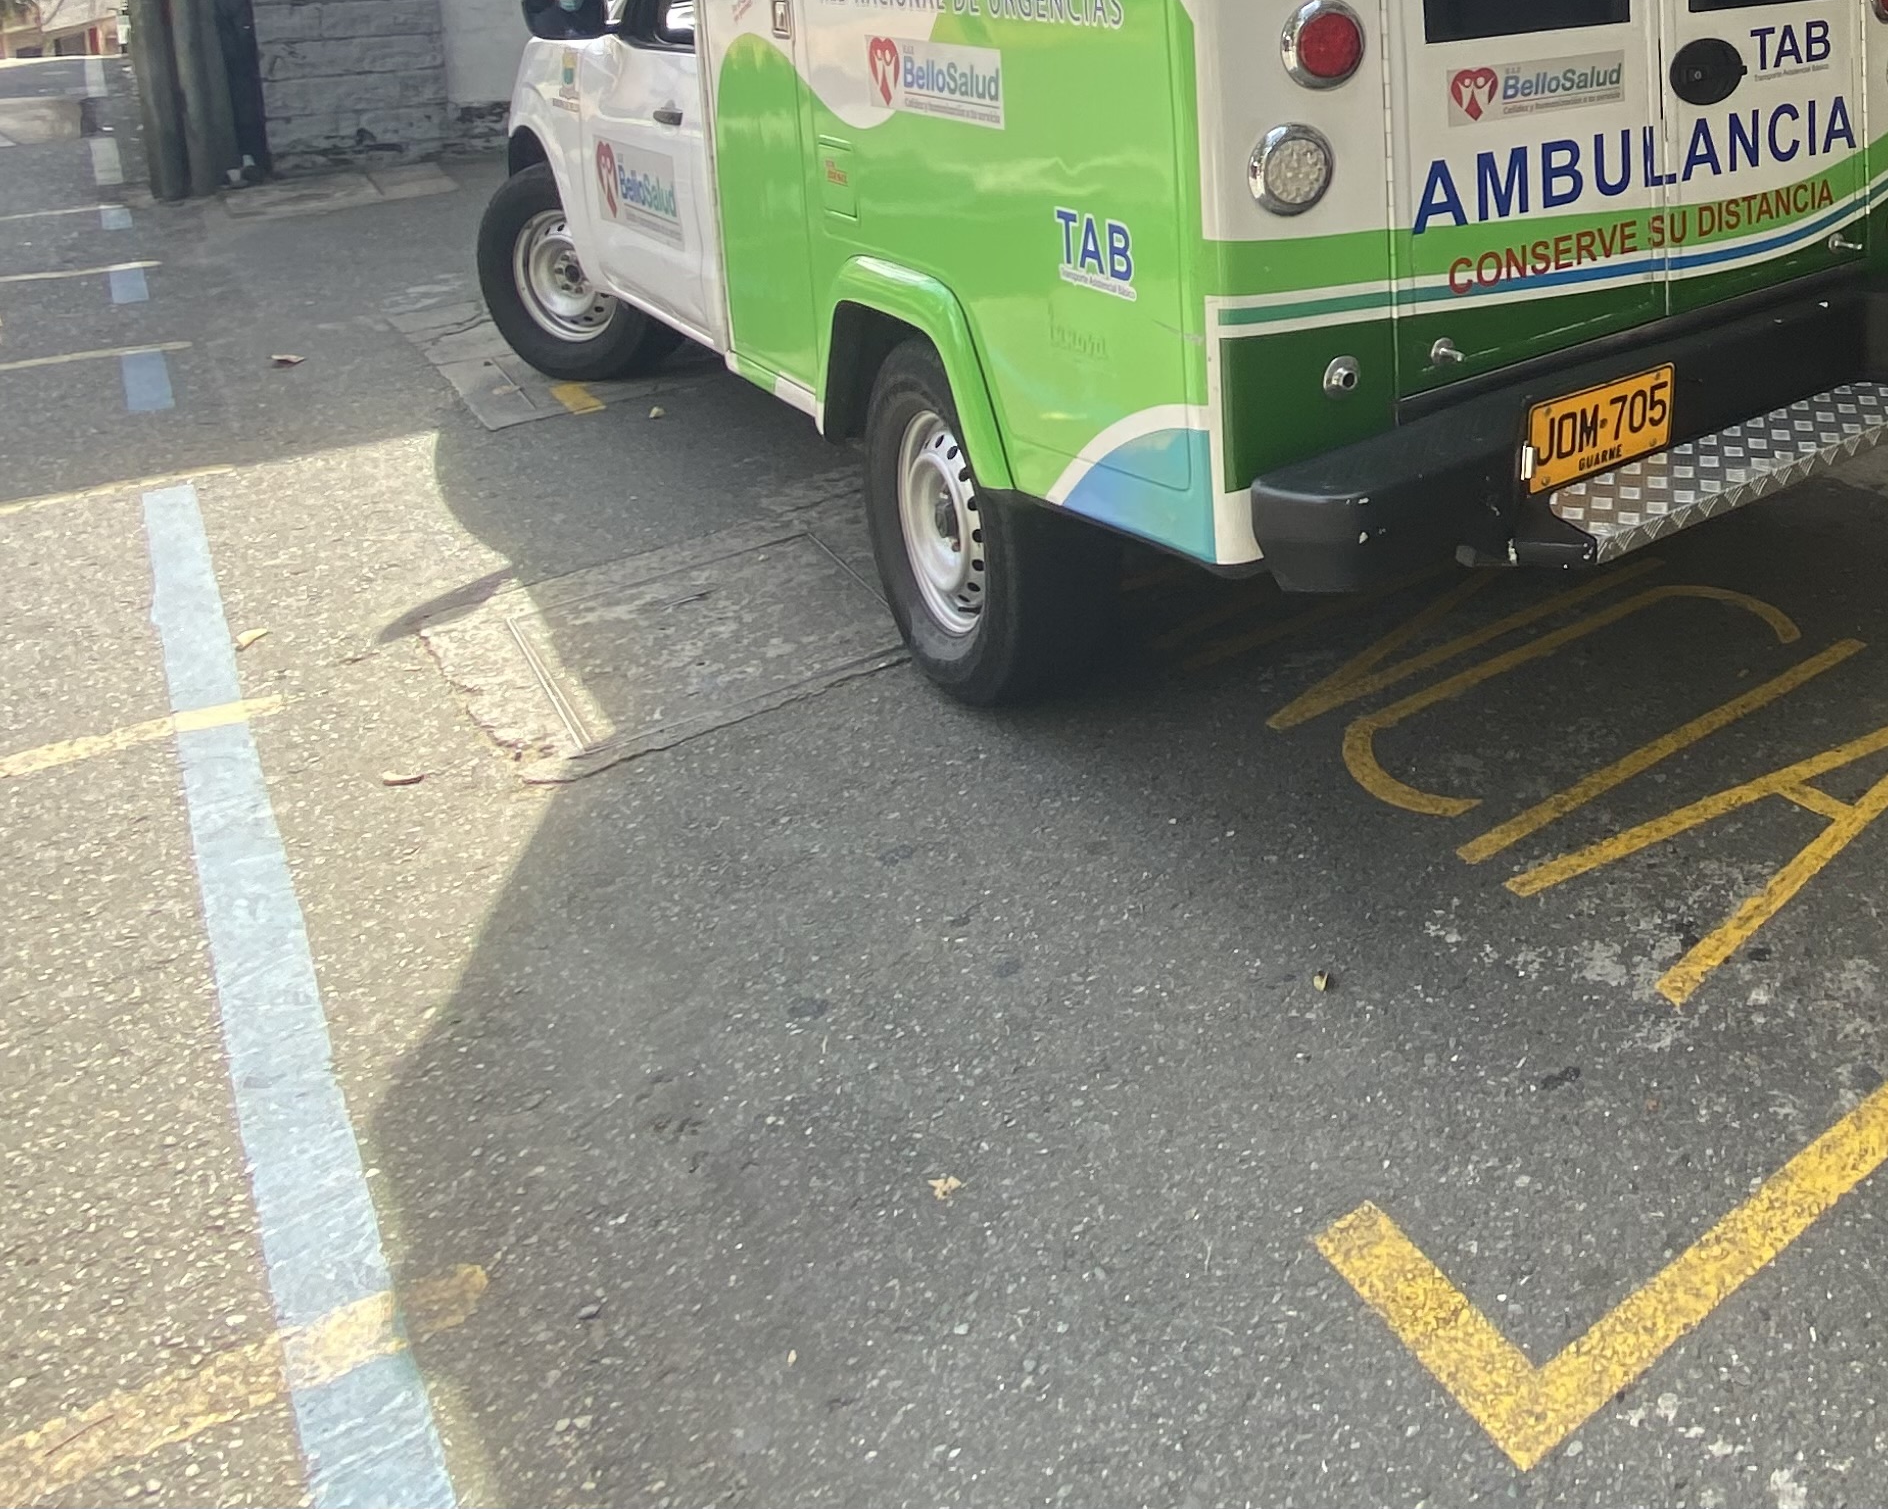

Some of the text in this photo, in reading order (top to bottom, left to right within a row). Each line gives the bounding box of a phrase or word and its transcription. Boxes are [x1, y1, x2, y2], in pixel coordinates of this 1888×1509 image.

[1750, 19, 1831, 71] TAB
[903, 55, 1000, 102] BelloSalud
[1502, 62, 1622, 100] BelloSalud
[1411, 95, 1858, 235] AMBULANCIA
[1056, 208, 1133, 282] TAB
[1448, 178, 1835, 294] CONSERVE SU DISTANCIA
[1578, 443, 1623, 472] GUARNE
